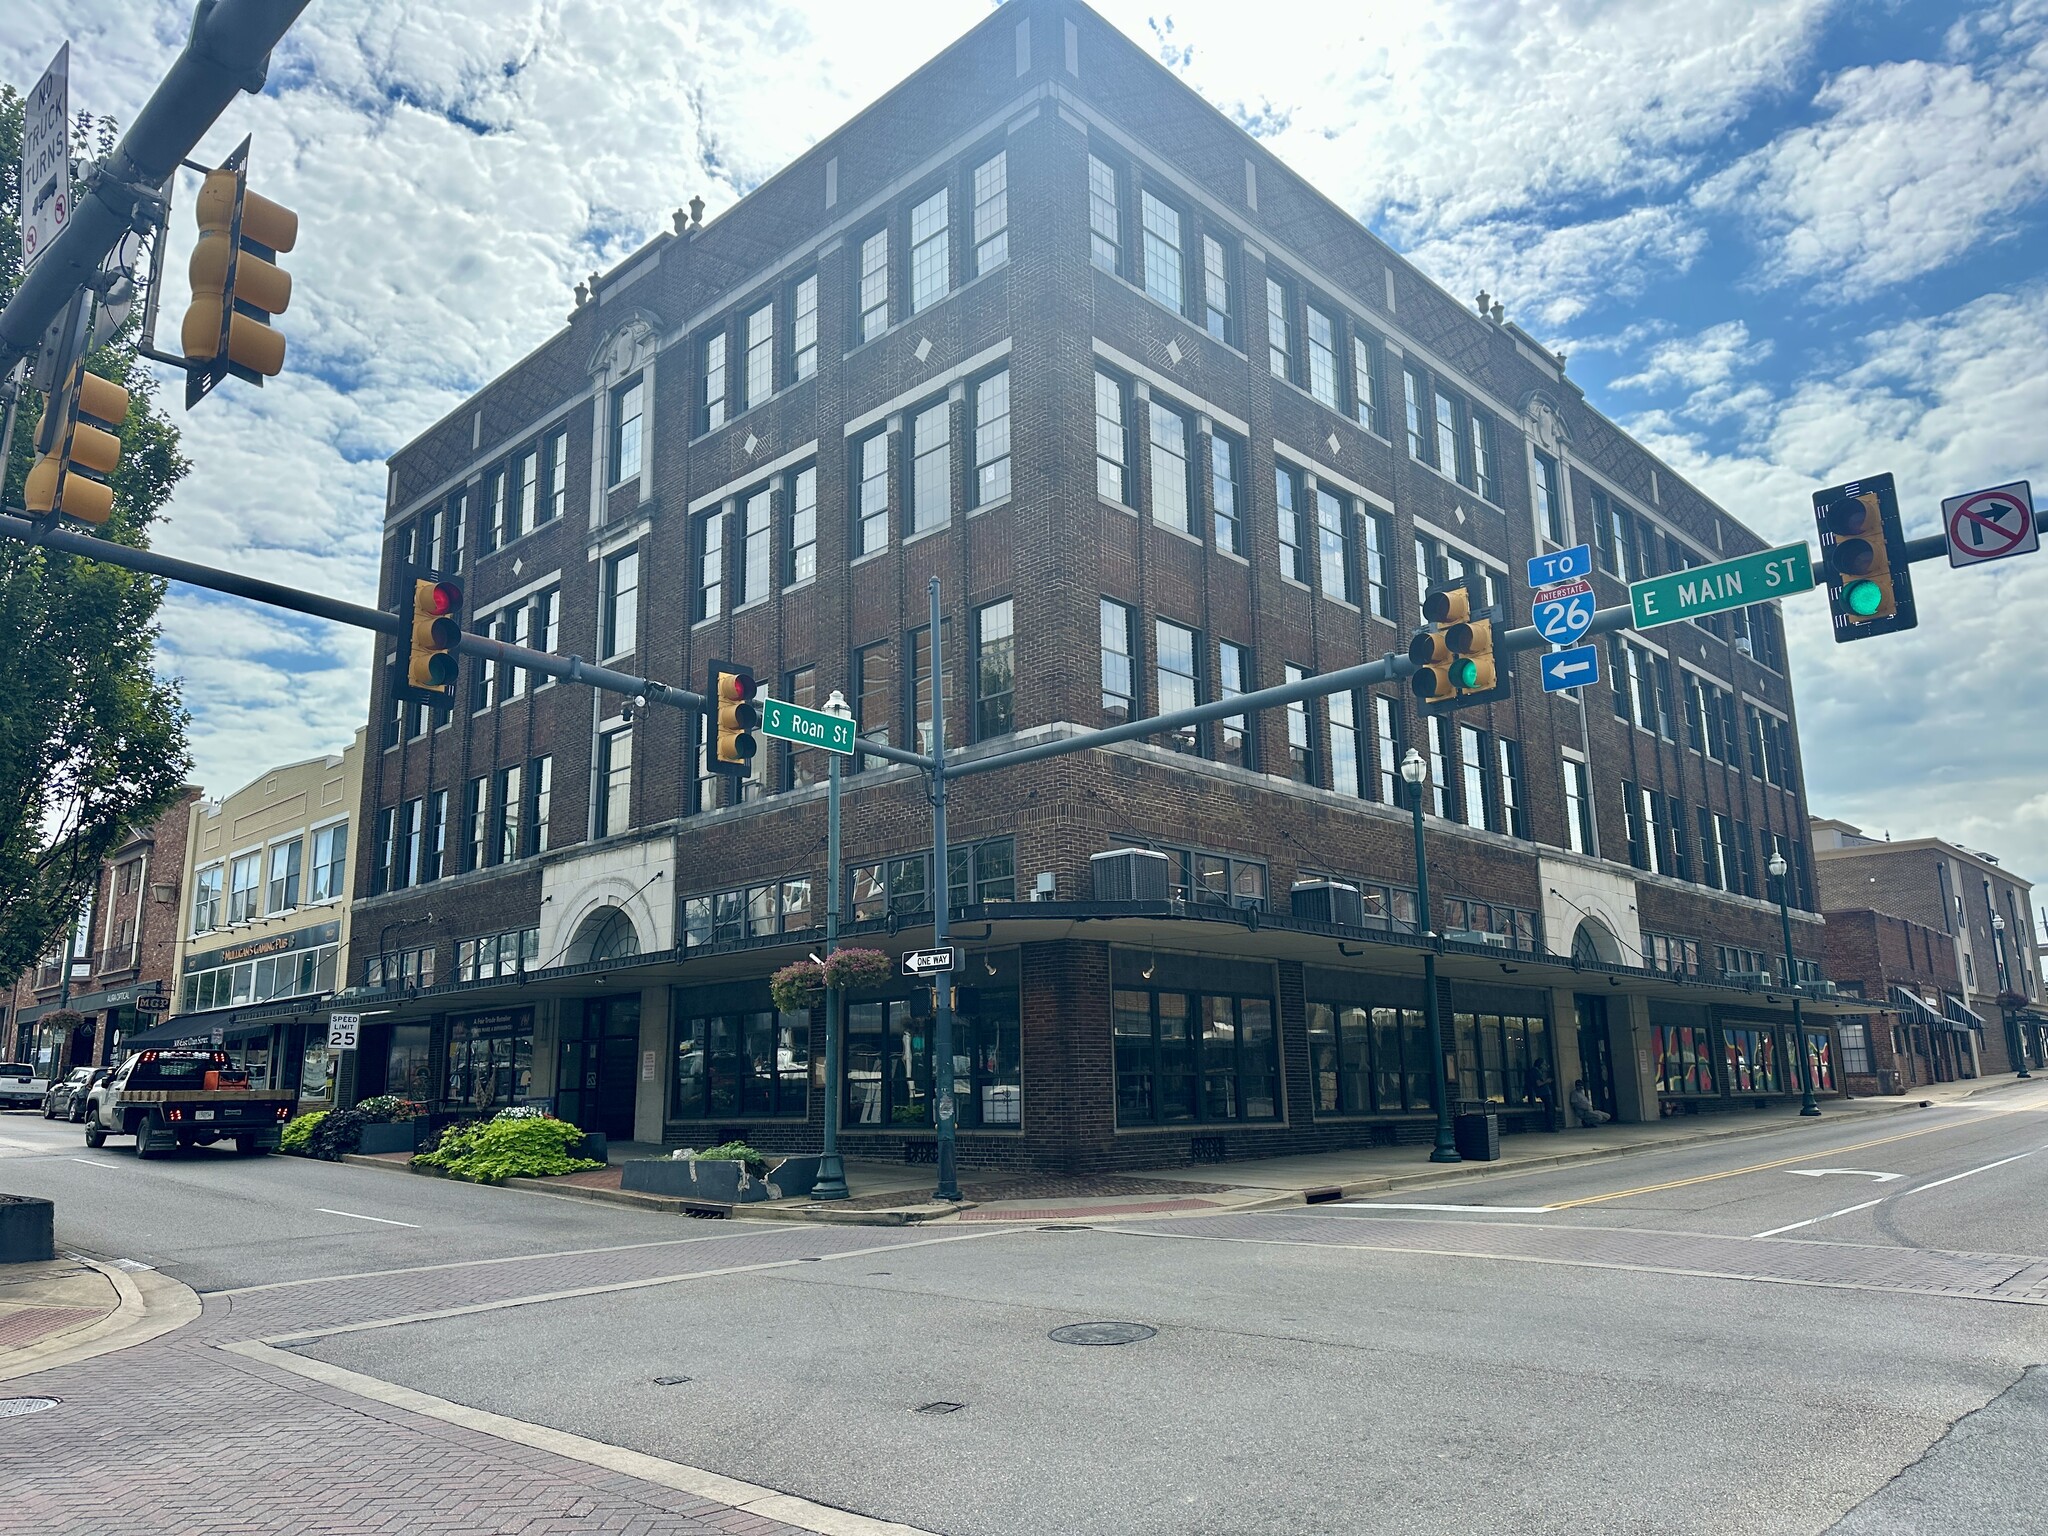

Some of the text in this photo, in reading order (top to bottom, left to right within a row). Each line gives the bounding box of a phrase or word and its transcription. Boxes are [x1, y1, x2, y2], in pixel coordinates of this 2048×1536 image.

[38, 73, 53, 111] NO
[27, 92, 63, 158] TRUCK
[26, 130, 64, 193] TURNS
[1544, 556, 1574, 577] TO
[1541, 583, 1584, 601] INTERSTATE
[1643, 557, 1797, 616] E MAIN ST
[1542, 597, 1590, 637] 26
[771, 709, 848, 745] S Roan St
[917, 955, 948, 966] ONE WAY
[140, 998, 169, 1008] MGP
[332, 1015, 358, 1023] SPEED
[330, 1032, 355, 1046] 25
